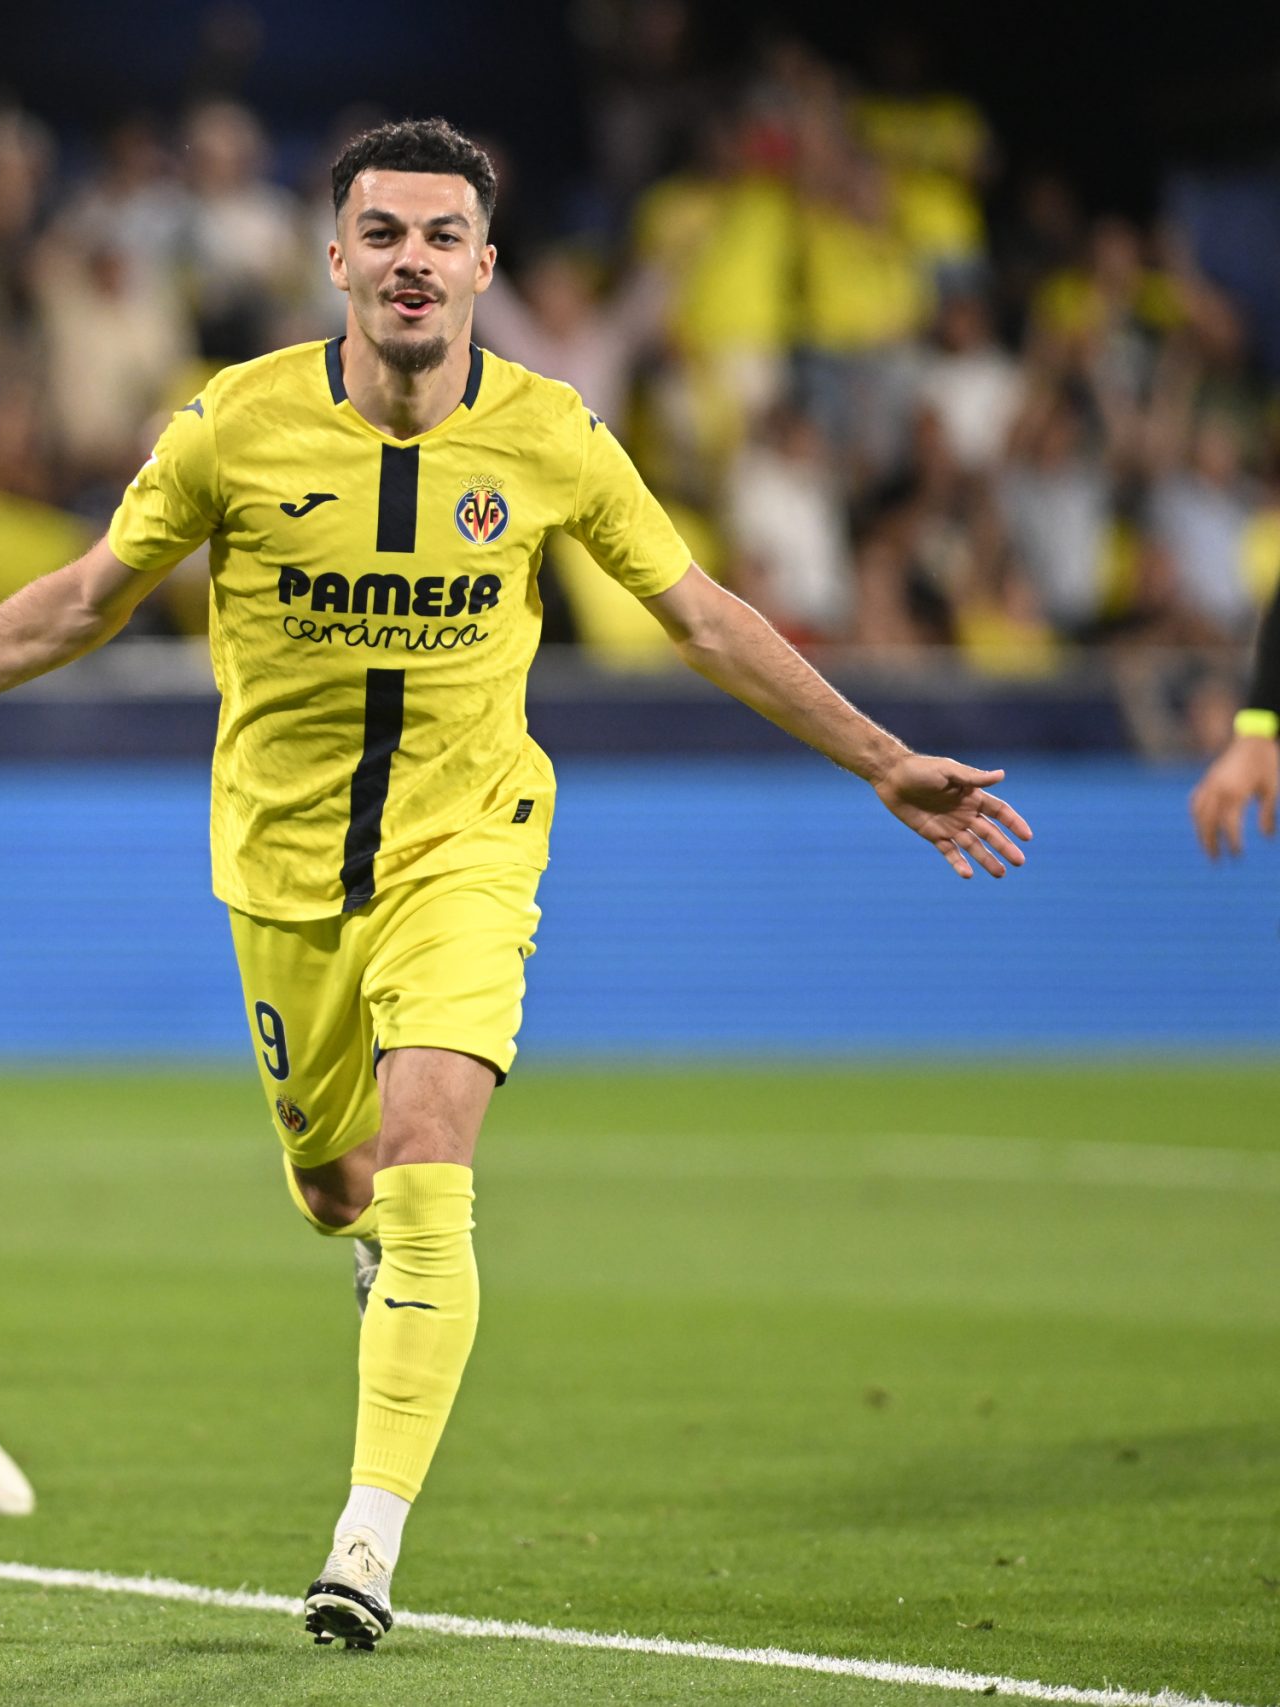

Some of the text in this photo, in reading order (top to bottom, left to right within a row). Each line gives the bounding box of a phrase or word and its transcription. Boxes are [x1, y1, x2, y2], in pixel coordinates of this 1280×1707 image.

[278, 565, 502, 617] PAMESA
[283, 616, 489, 650] cerámica
[254, 999, 290, 1081] 9
